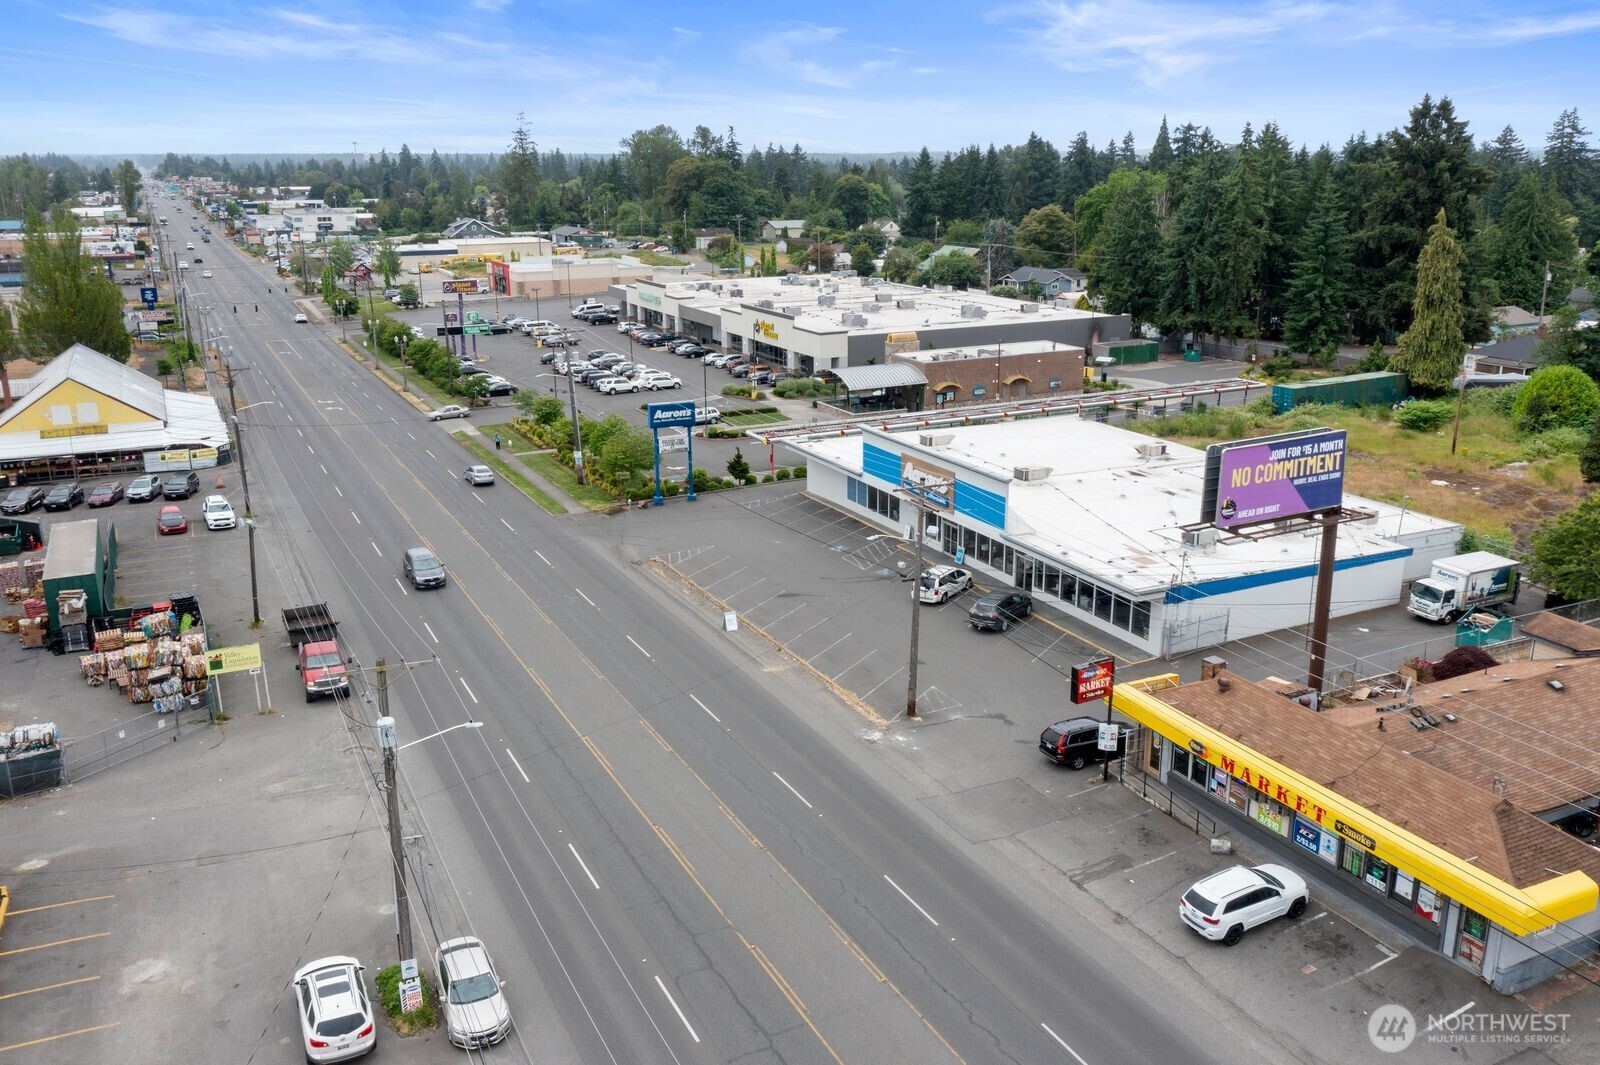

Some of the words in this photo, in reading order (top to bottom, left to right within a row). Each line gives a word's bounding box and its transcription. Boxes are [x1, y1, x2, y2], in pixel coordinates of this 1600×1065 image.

[653, 409, 692, 419] Aaron's
[1269, 448, 1286, 460] JOIN
[1287, 446, 1301, 458] FOR
[1302, 444, 1313, 455] $15
[1313, 443, 1319, 454] A
[1320, 439, 1344, 452] MONTH
[1231, 467, 1251, 488] NO
[1255, 451, 1343, 484] COMMITMENT
[1238, 508, 1256, 518] AHEAD
[1256, 507, 1264, 516] ON
[1264, 504, 1280, 514] RIGHT
[1079, 677, 1111, 692] MARKET
[1221, 754, 1327, 823] MARKET
[1342, 824, 1371, 847] Smoke
